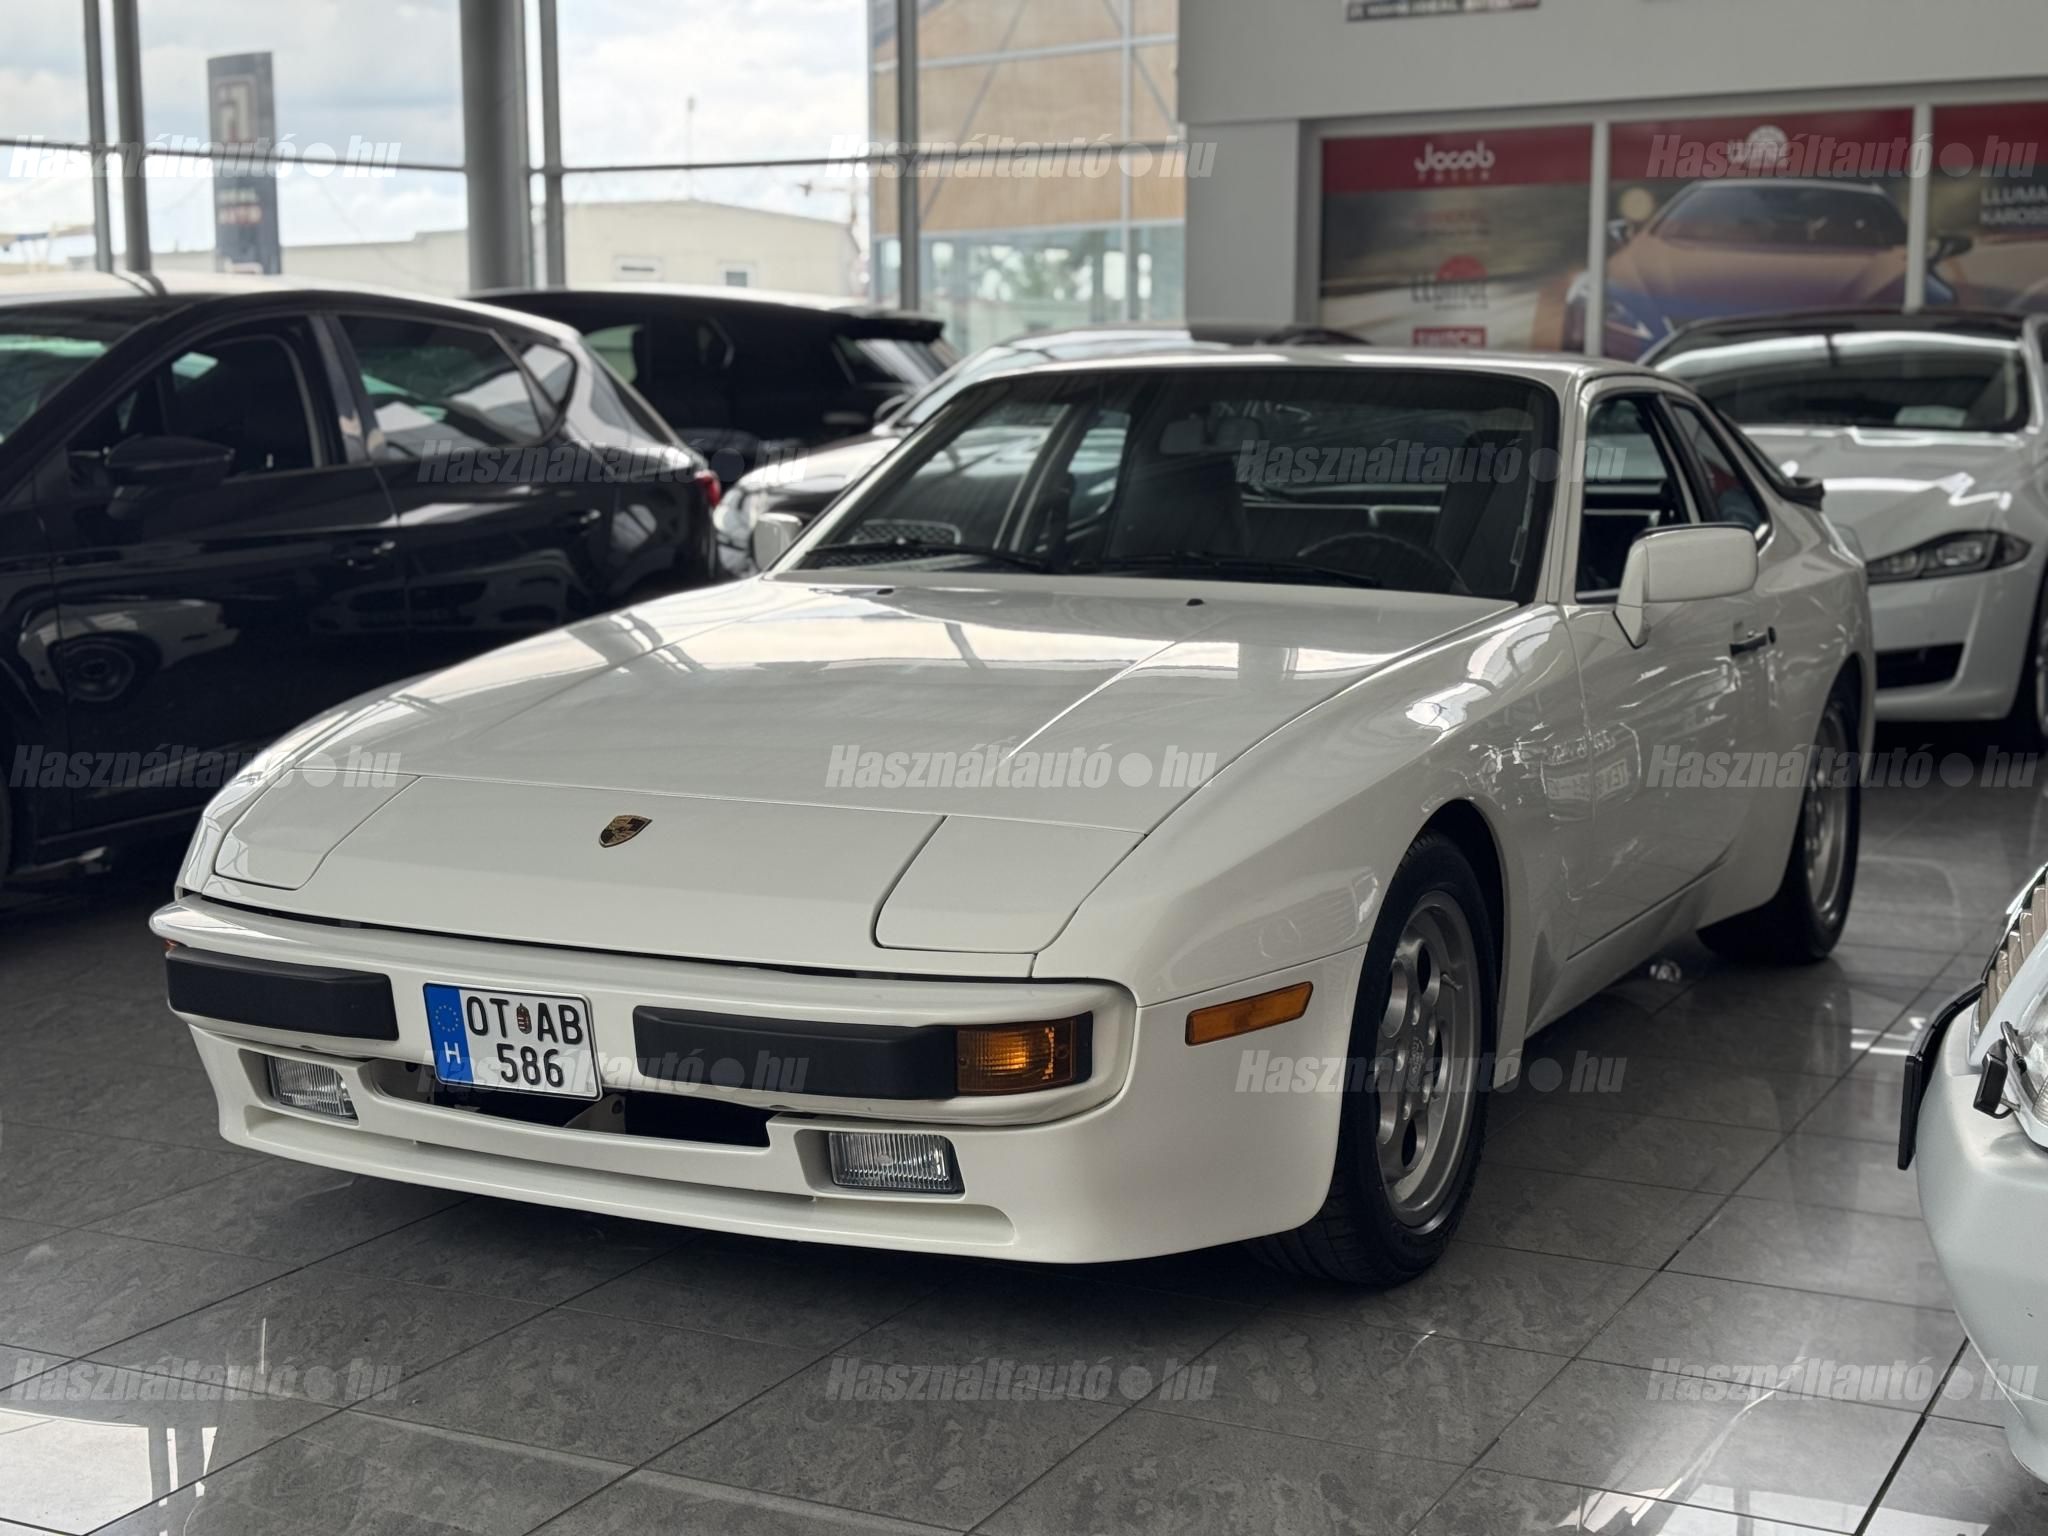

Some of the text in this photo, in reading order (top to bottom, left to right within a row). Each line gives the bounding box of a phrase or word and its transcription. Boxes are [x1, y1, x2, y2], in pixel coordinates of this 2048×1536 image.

[466, 996, 584, 1046] OT AB
[444, 1041, 462, 1065] H
[496, 1043, 565, 1088] 586
